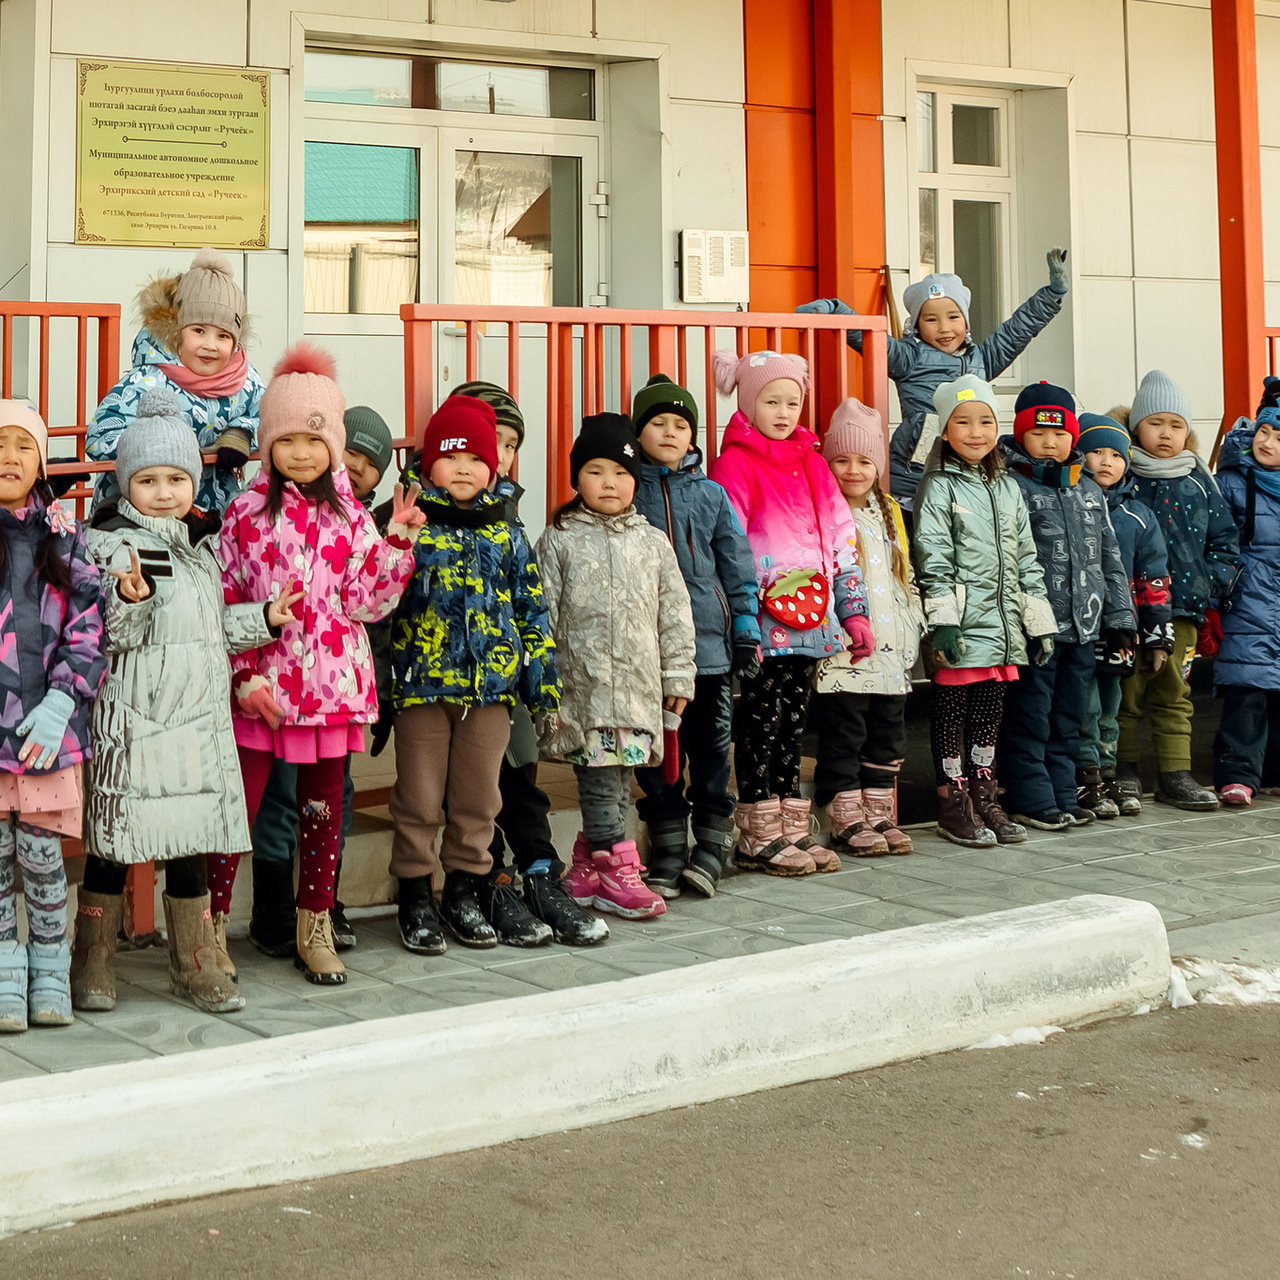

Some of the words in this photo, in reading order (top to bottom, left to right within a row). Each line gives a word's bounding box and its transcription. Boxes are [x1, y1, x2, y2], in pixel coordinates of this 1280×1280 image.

[156, 88, 184, 97] урдахи
[186, 88, 243, 101] болбосоролой
[89, 102, 124, 110] нютагай
[126, 104, 157, 112] засагай
[158, 104, 176, 112] бэеэ
[228, 110, 259, 119] зургаан
[92, 117, 137, 129] Эрхирэгэй
[176, 124, 211, 134] сэсэрлиг
[89, 149, 158, 160] Муниципальное
[159, 155, 208, 163] автономное
[210, 157, 258, 165] дошкольное
[114, 167, 184, 179] образовательное
[186, 173, 235, 182] учреждение
[99, 185, 156, 196] Эрхирикский
[158, 189, 190, 197] детский
[127, 210, 159, 218] Республика
[440, 438, 468, 451] UFC
